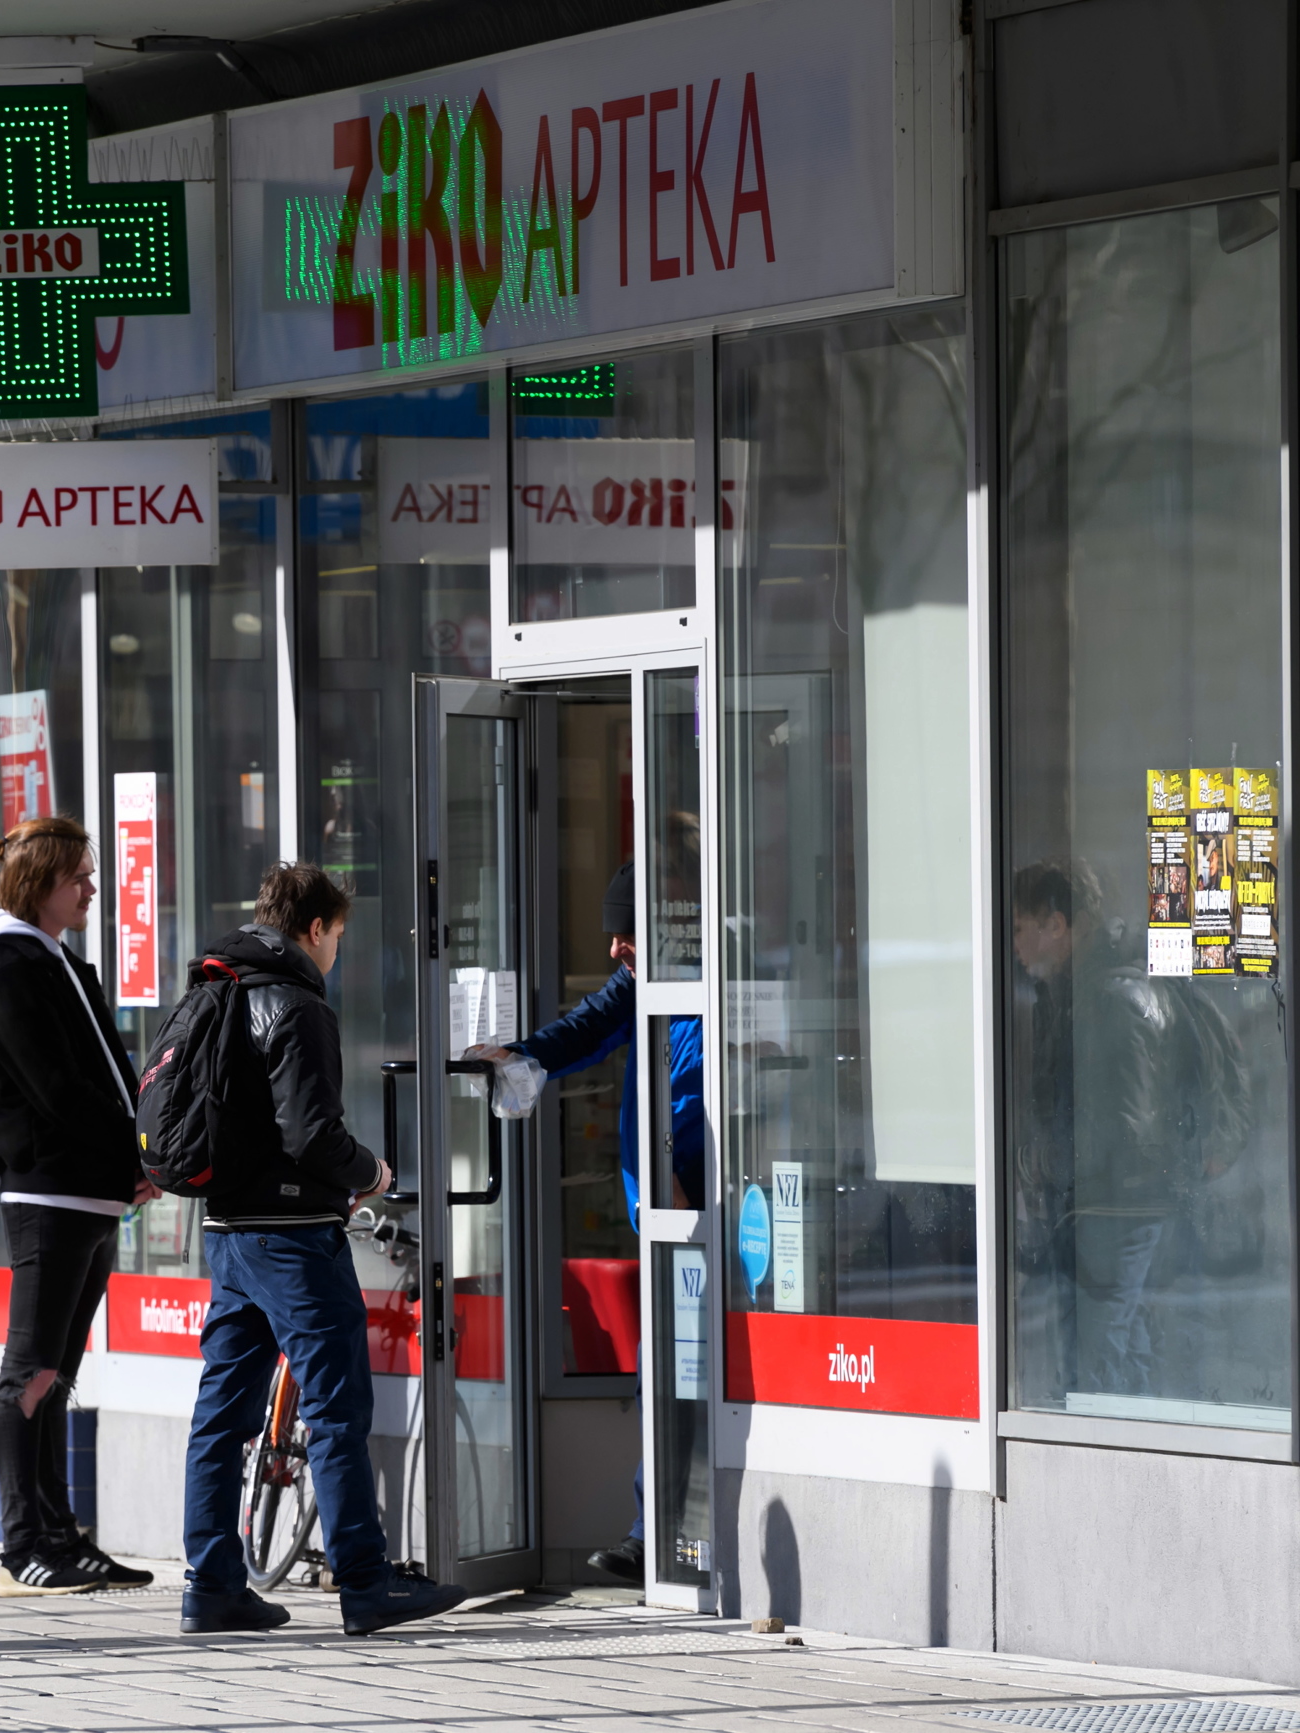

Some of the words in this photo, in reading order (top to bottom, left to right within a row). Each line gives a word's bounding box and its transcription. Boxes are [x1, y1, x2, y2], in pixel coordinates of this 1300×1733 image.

[522, 72, 775, 304] APTEKA
[17, 484, 204, 529] APTEKA
[776, 1173, 800, 1208] NFZ
[682, 1267, 702, 1298] NFZ
[781, 1280, 795, 1290] TENA
[140, 1297, 187, 1334] Infolinia:
[828, 1343, 875, 1393] ziko.pl
